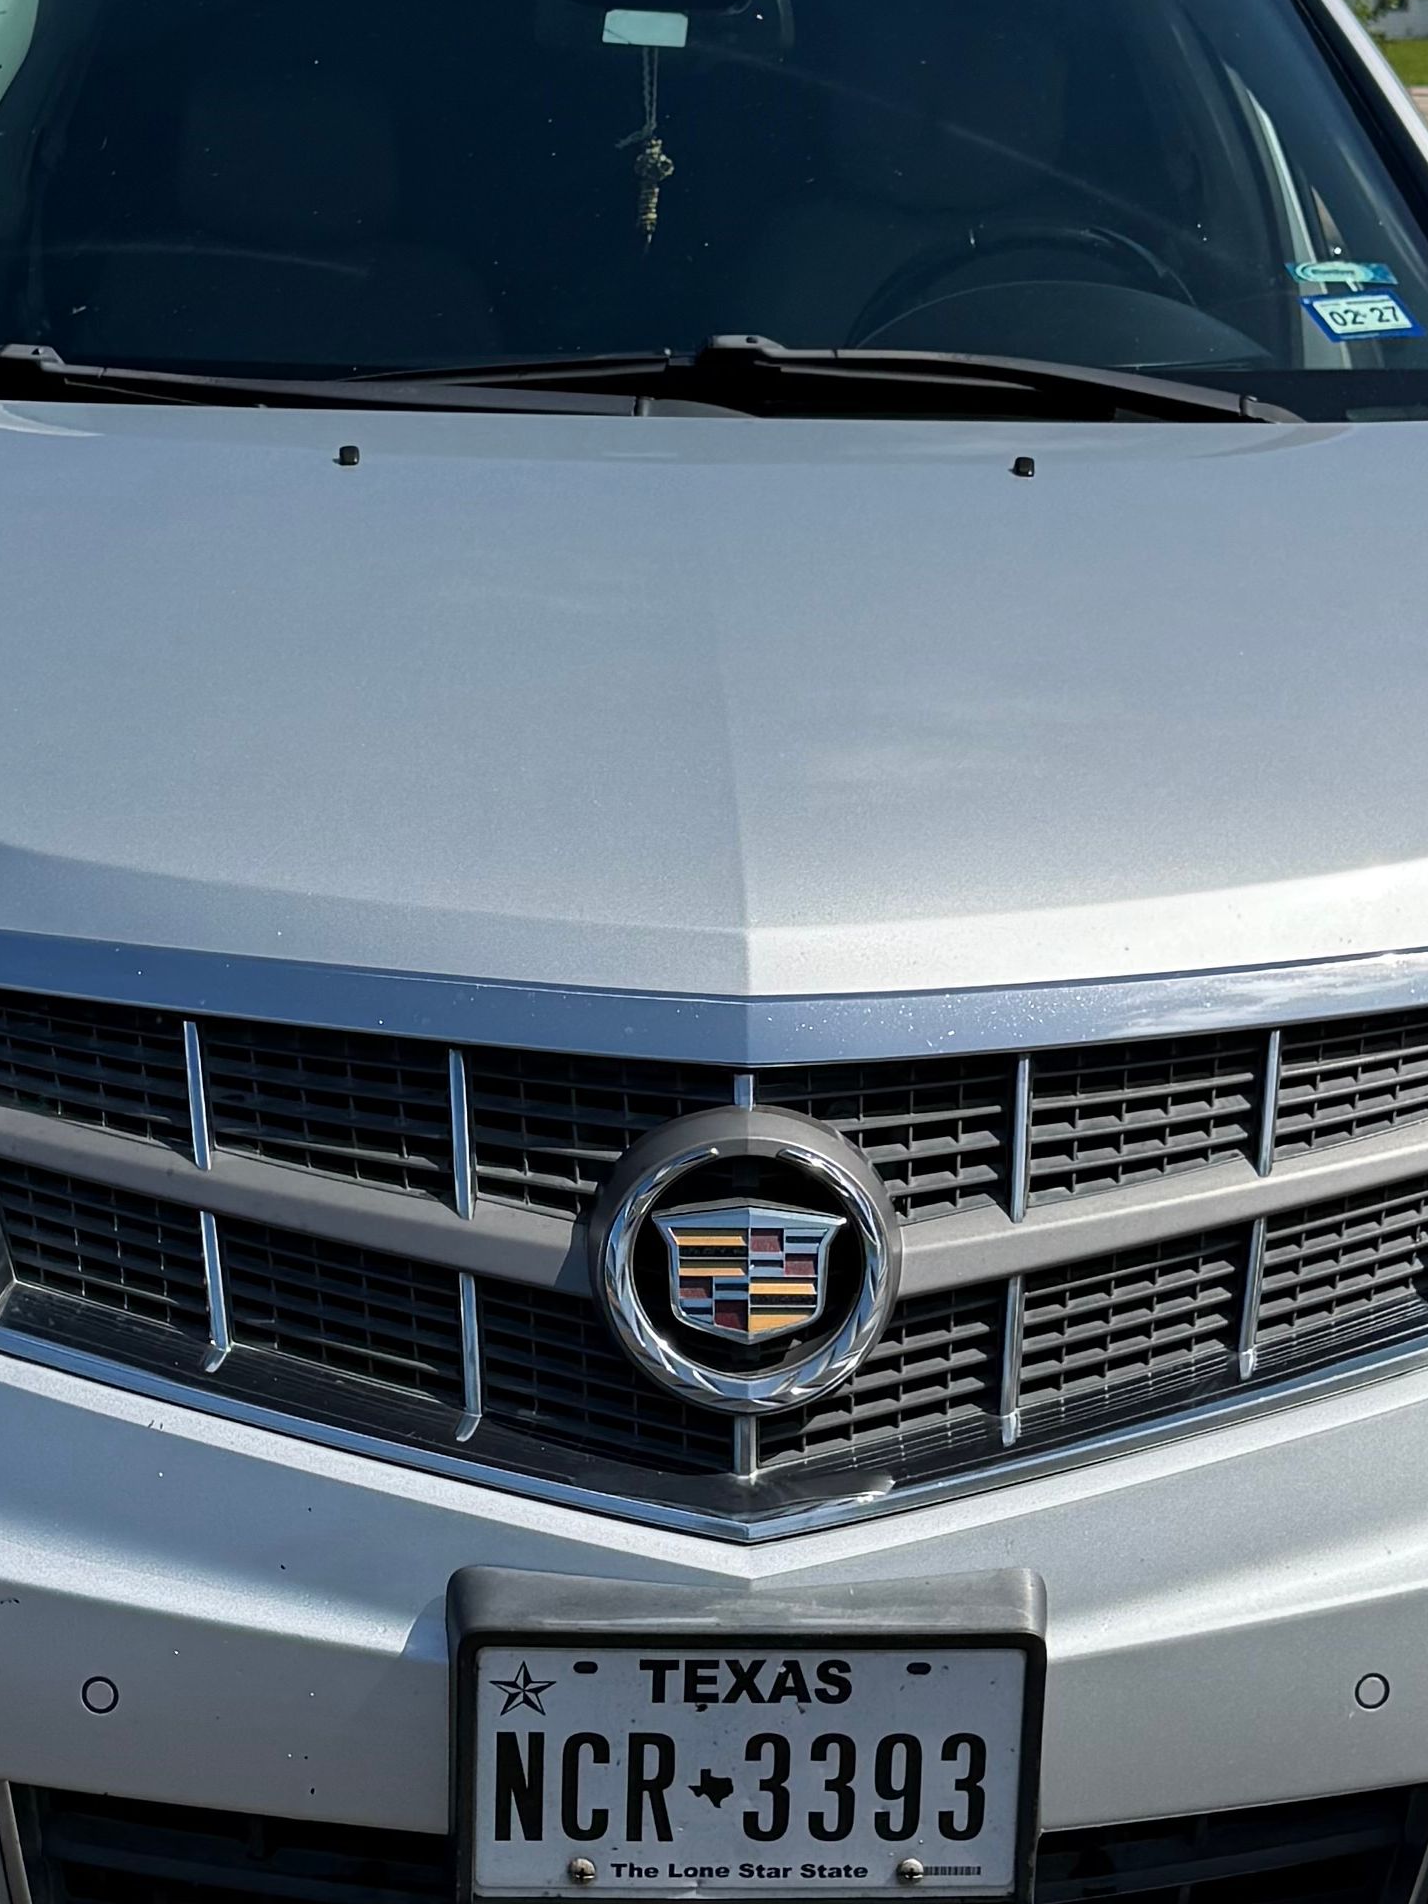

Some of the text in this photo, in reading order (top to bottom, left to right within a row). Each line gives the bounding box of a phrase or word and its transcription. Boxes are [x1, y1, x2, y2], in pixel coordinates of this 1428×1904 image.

[639, 1659, 853, 1705] TEXAS
[494, 1731, 987, 1842] NCR 3393
[610, 1862, 869, 1879] The Lone Star State
